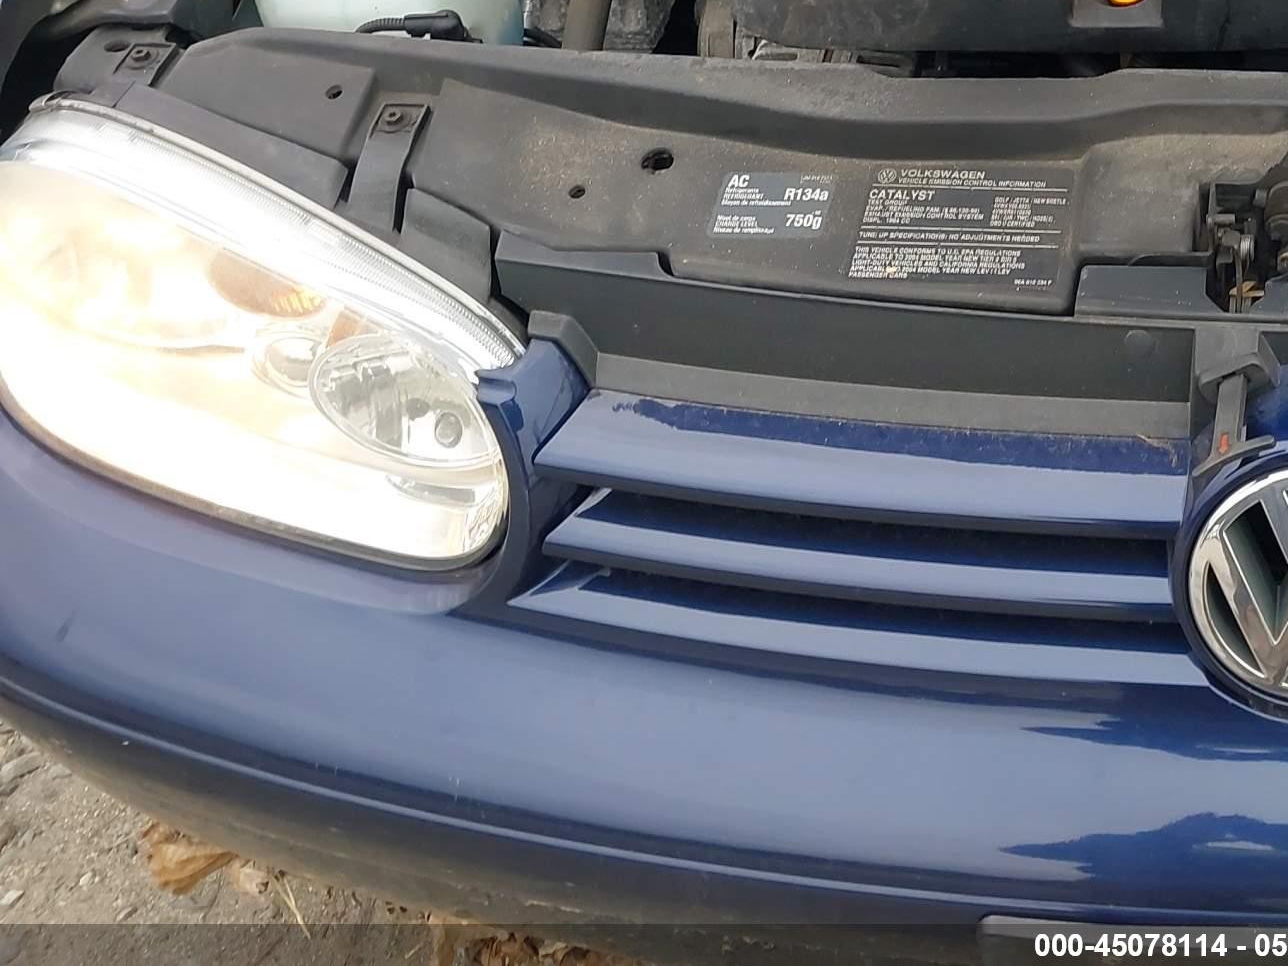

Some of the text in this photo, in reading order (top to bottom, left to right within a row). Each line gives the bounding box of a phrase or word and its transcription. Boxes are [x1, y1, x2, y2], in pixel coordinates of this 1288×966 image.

[901, 169, 986, 179] VOLKSWAGEN
[728, 174, 750, 188] AC
[898, 177, 1047, 188] VEHICLE EMISSION CONTROL INFORMATION
[783, 187, 829, 201] R134a
[869, 189, 936, 201] CATALYST
[785, 213, 822, 230] 750g
[1011, 235, 1040, 243] NEEDED
